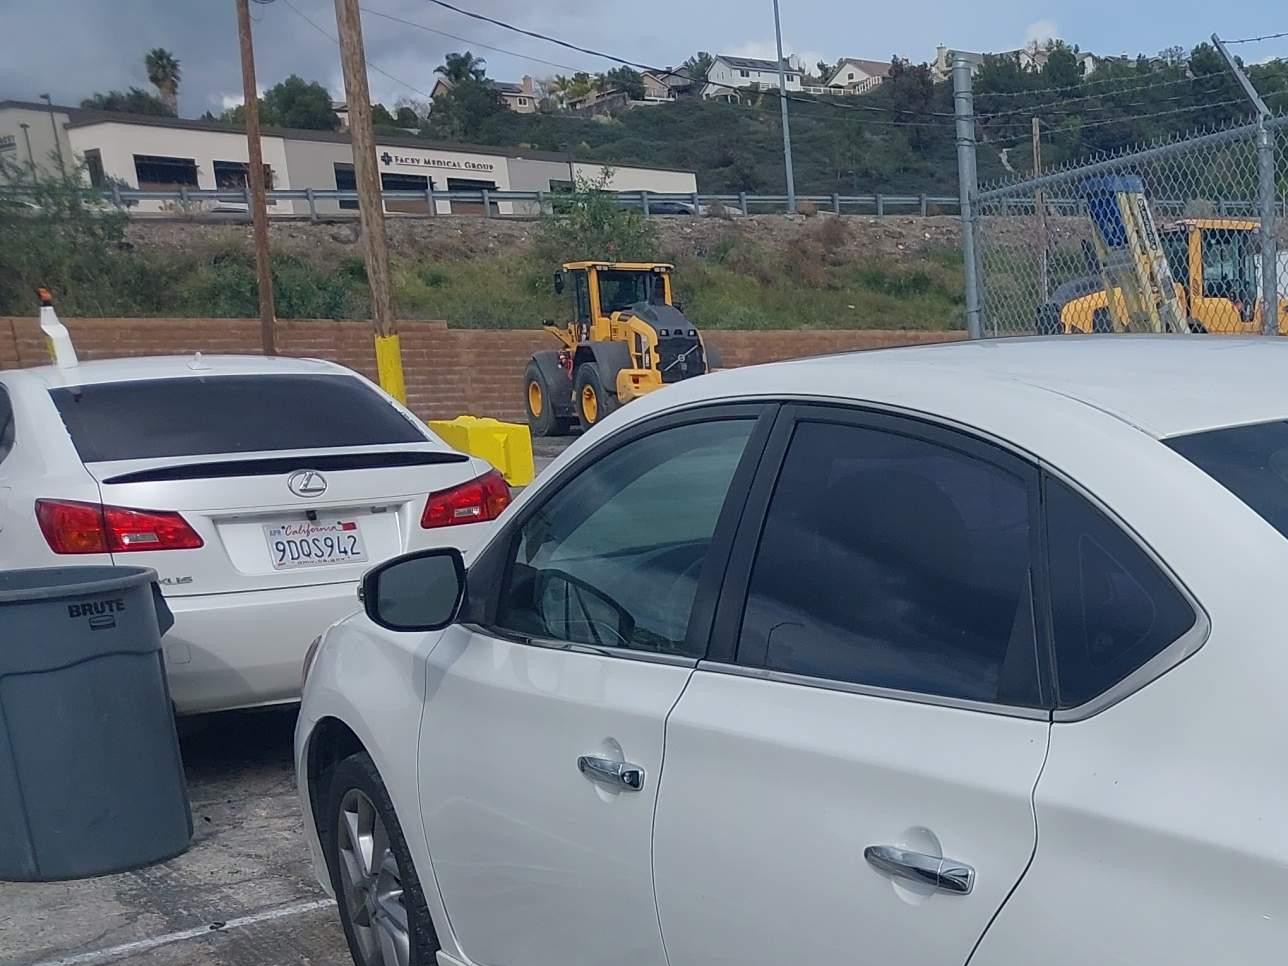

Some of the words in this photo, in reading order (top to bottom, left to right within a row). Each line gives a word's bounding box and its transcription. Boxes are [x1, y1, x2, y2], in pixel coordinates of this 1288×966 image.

[423, 157, 462, 169] MEDICAL
[465, 161, 494, 171] GROUP
[285, 524, 338, 538] California
[275, 535, 360, 562] 9DQS942
[67, 599, 126, 618] BRUTE
